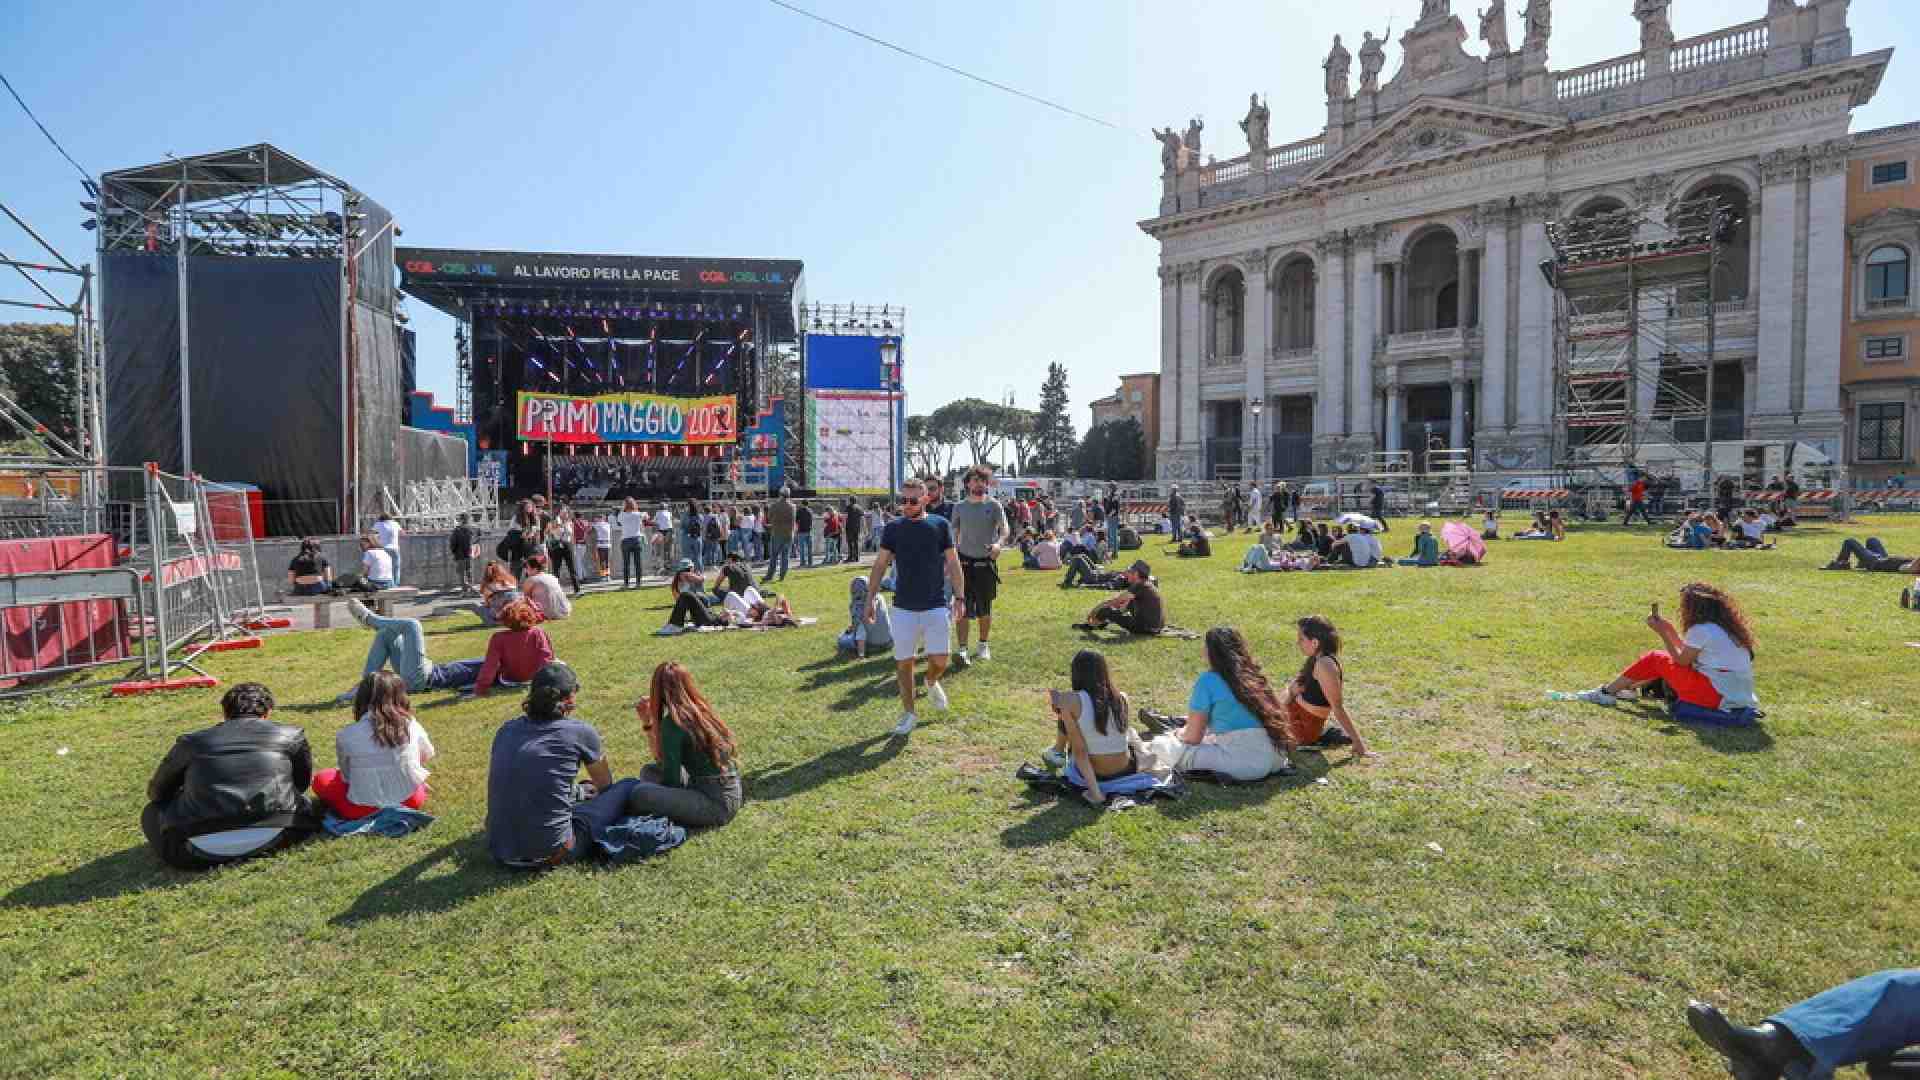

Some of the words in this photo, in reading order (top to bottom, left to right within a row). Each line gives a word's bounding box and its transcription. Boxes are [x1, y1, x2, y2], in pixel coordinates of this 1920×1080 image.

[513, 264, 532, 277] AL
[536, 265, 590, 279] LAVORO
[593, 267, 621, 280] PER
[624, 269, 640, 281] LA
[644, 269, 681, 281] PACE
[527, 398, 598, 433] PRIMO
[602, 400, 682, 435] MAGGIO
